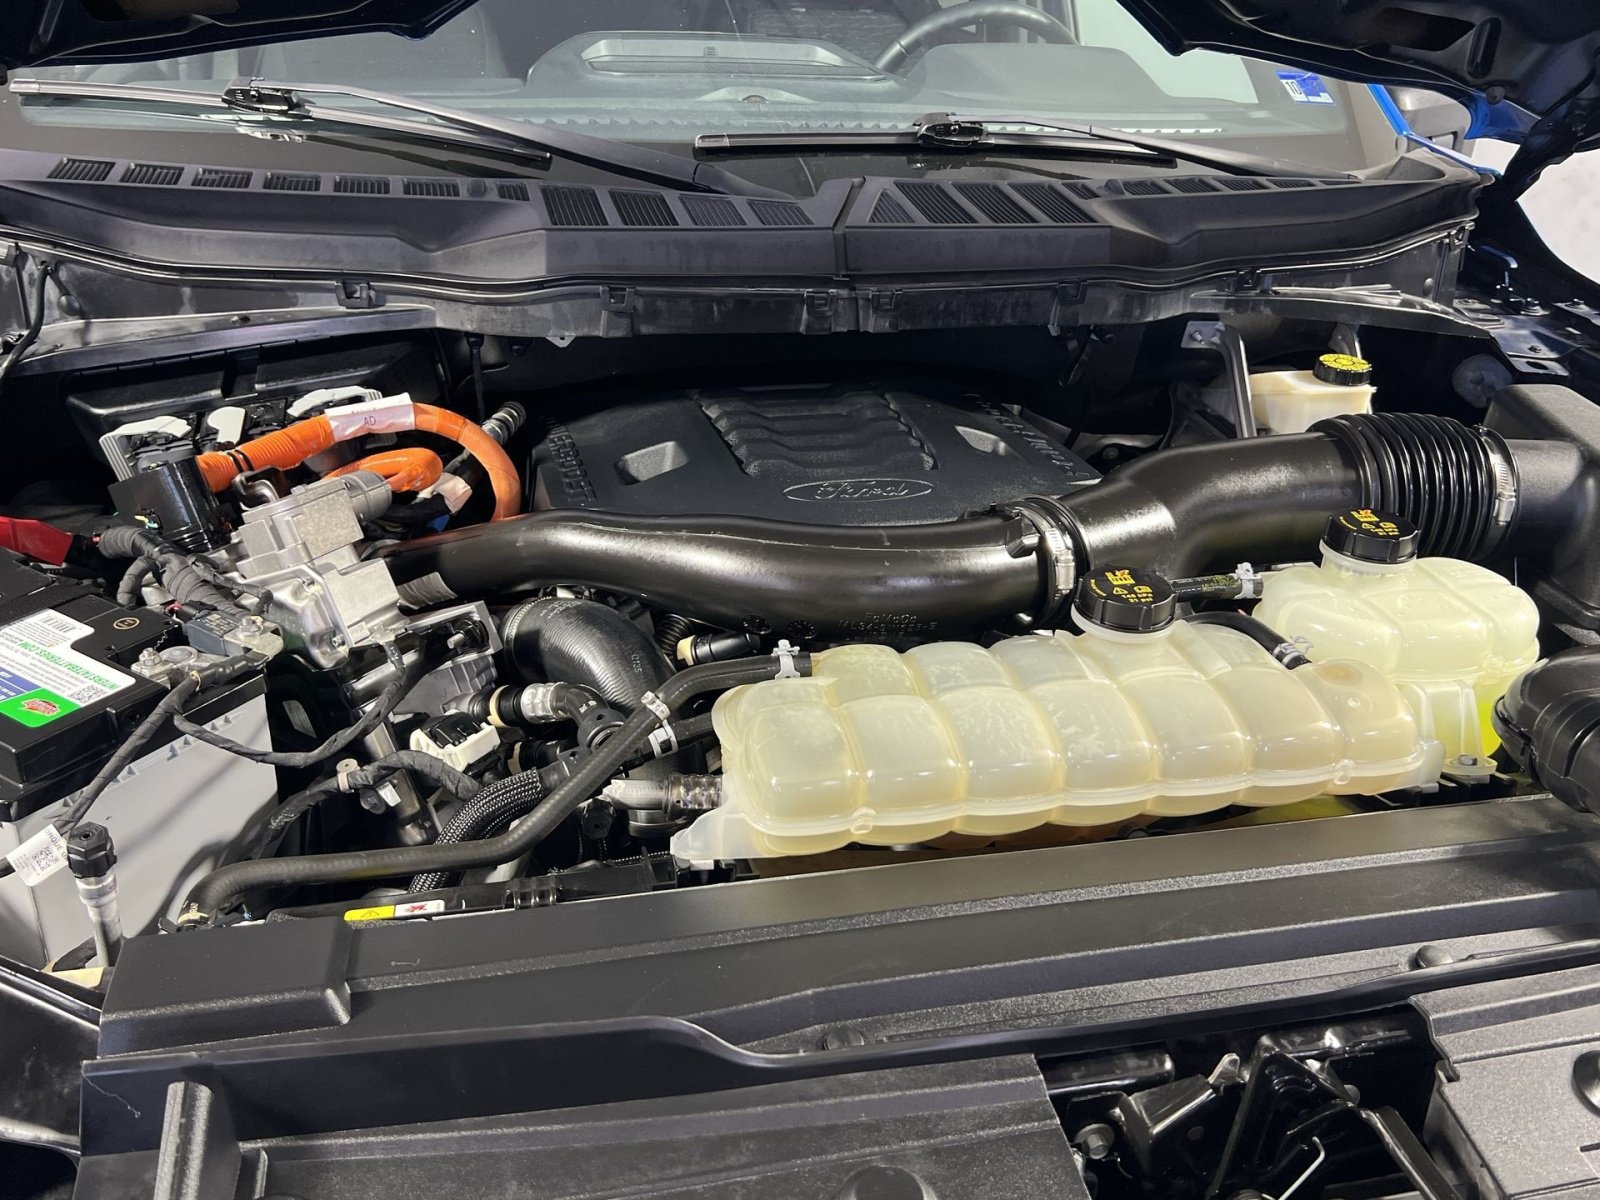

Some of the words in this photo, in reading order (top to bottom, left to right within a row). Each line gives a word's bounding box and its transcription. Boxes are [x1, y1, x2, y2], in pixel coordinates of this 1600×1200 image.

[1285, 81, 1302, 95] 10
[364, 415, 377, 427] AD
[815, 481, 909, 500] Ford
